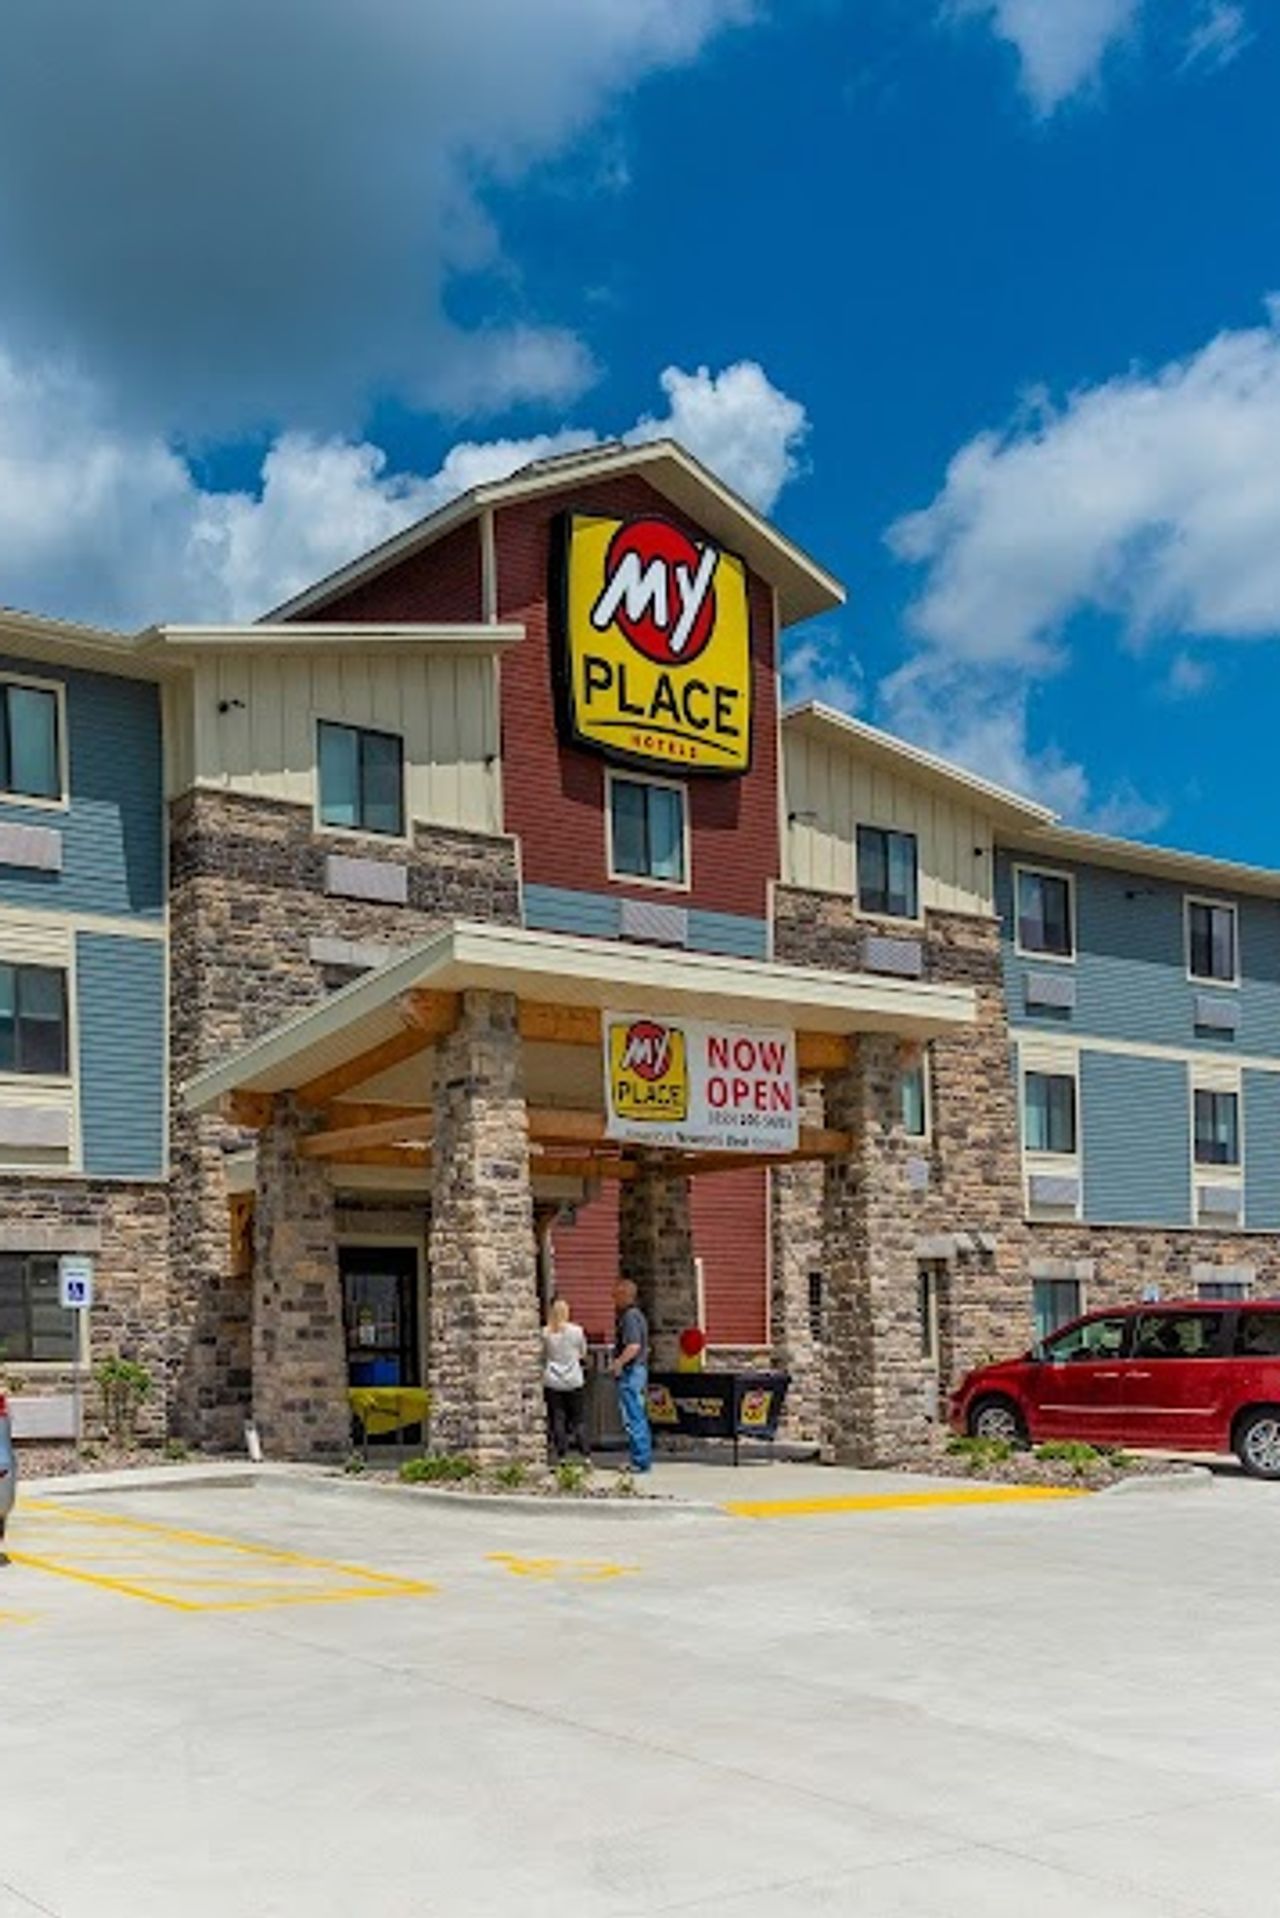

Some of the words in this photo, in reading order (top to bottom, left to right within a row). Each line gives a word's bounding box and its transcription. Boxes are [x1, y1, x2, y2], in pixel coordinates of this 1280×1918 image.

[583, 654, 740, 736] PLACE
[630, 733, 698, 759] HOTELS
[706, 1036, 786, 1075] NOW
[617, 1080, 682, 1105] PLACE
[706, 1077, 792, 1112] OPEN
